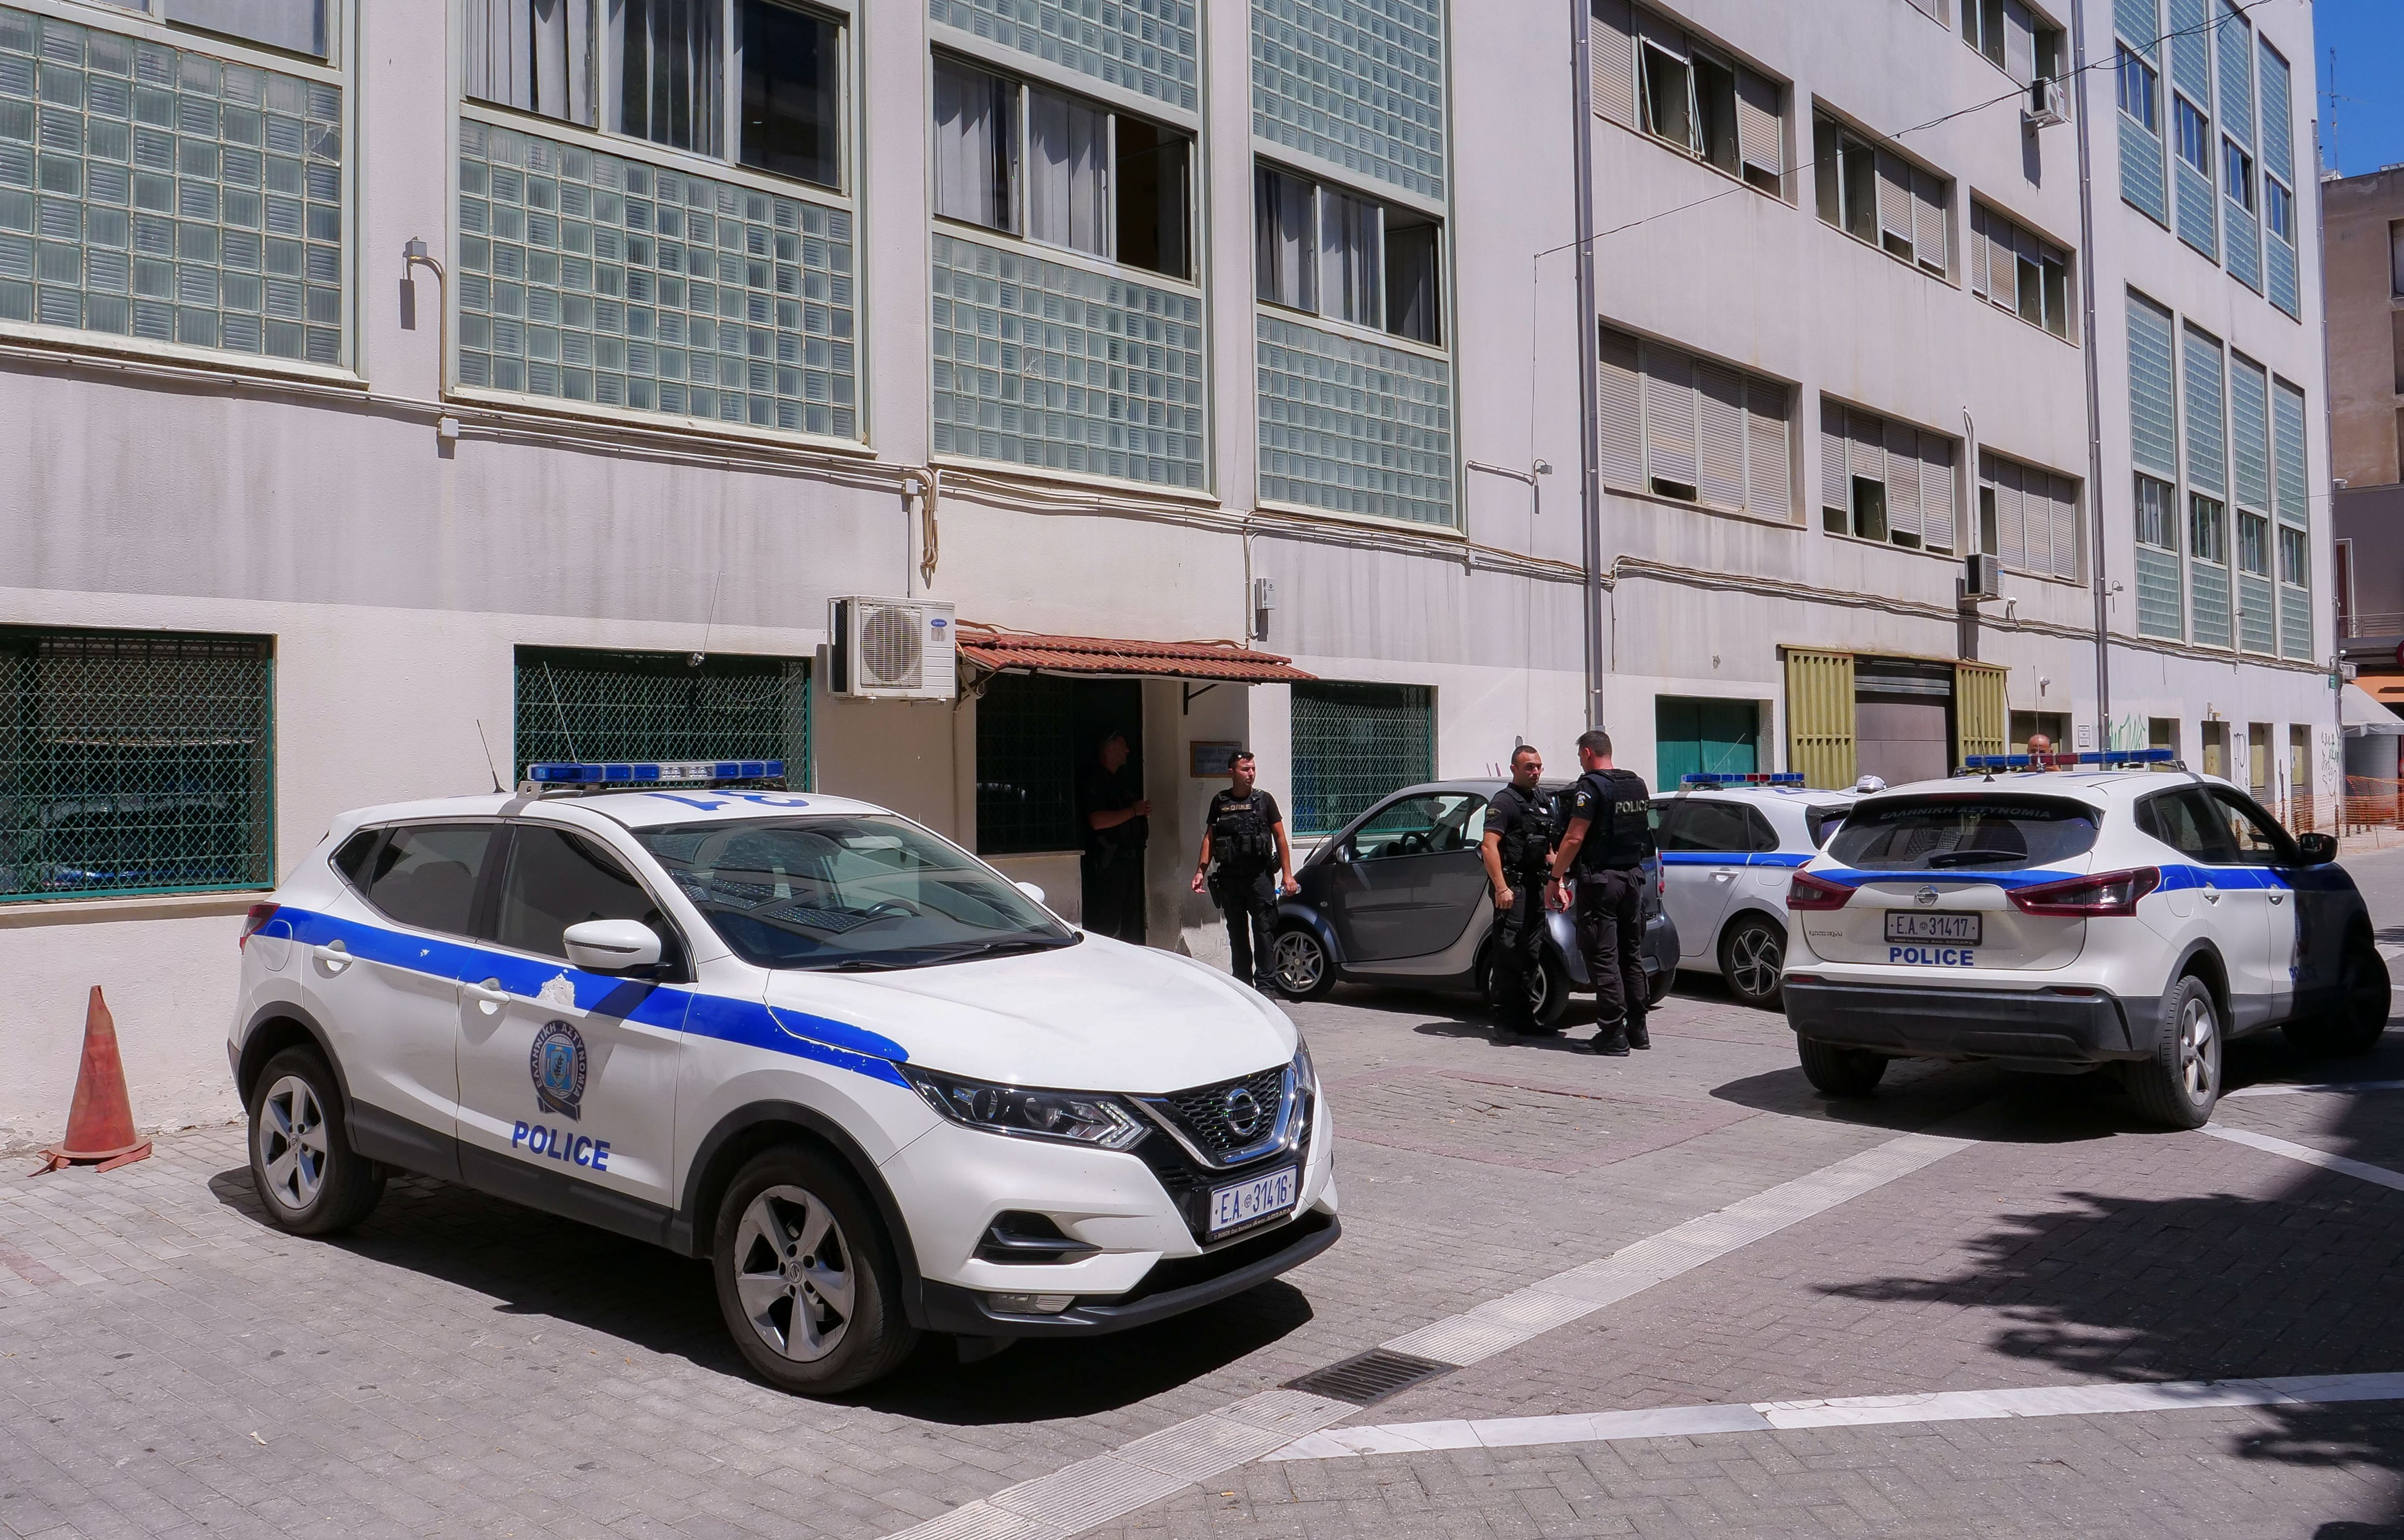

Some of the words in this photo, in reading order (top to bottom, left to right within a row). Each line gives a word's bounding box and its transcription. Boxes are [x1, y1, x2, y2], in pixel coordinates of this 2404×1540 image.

[1615, 799, 1649, 813] POLICE
[1880, 807, 1955, 819] ΕΛΛΗΝΙΚΗ
[1957, 806, 2051, 818] ΑΣΤΥΝΟΜΙΑ
[1929, 917, 1968, 937] 31417
[1890, 947, 1974, 966] POLICE
[532, 1023, 556, 1088] ΕΛΛΗΝΙΚΗ
[561, 1023, 586, 1098] ΑΣΤΥΝΟΜΙΑ
[512, 1120, 610, 1172] POLICE
[1253, 1174, 1287, 1213] 31416
